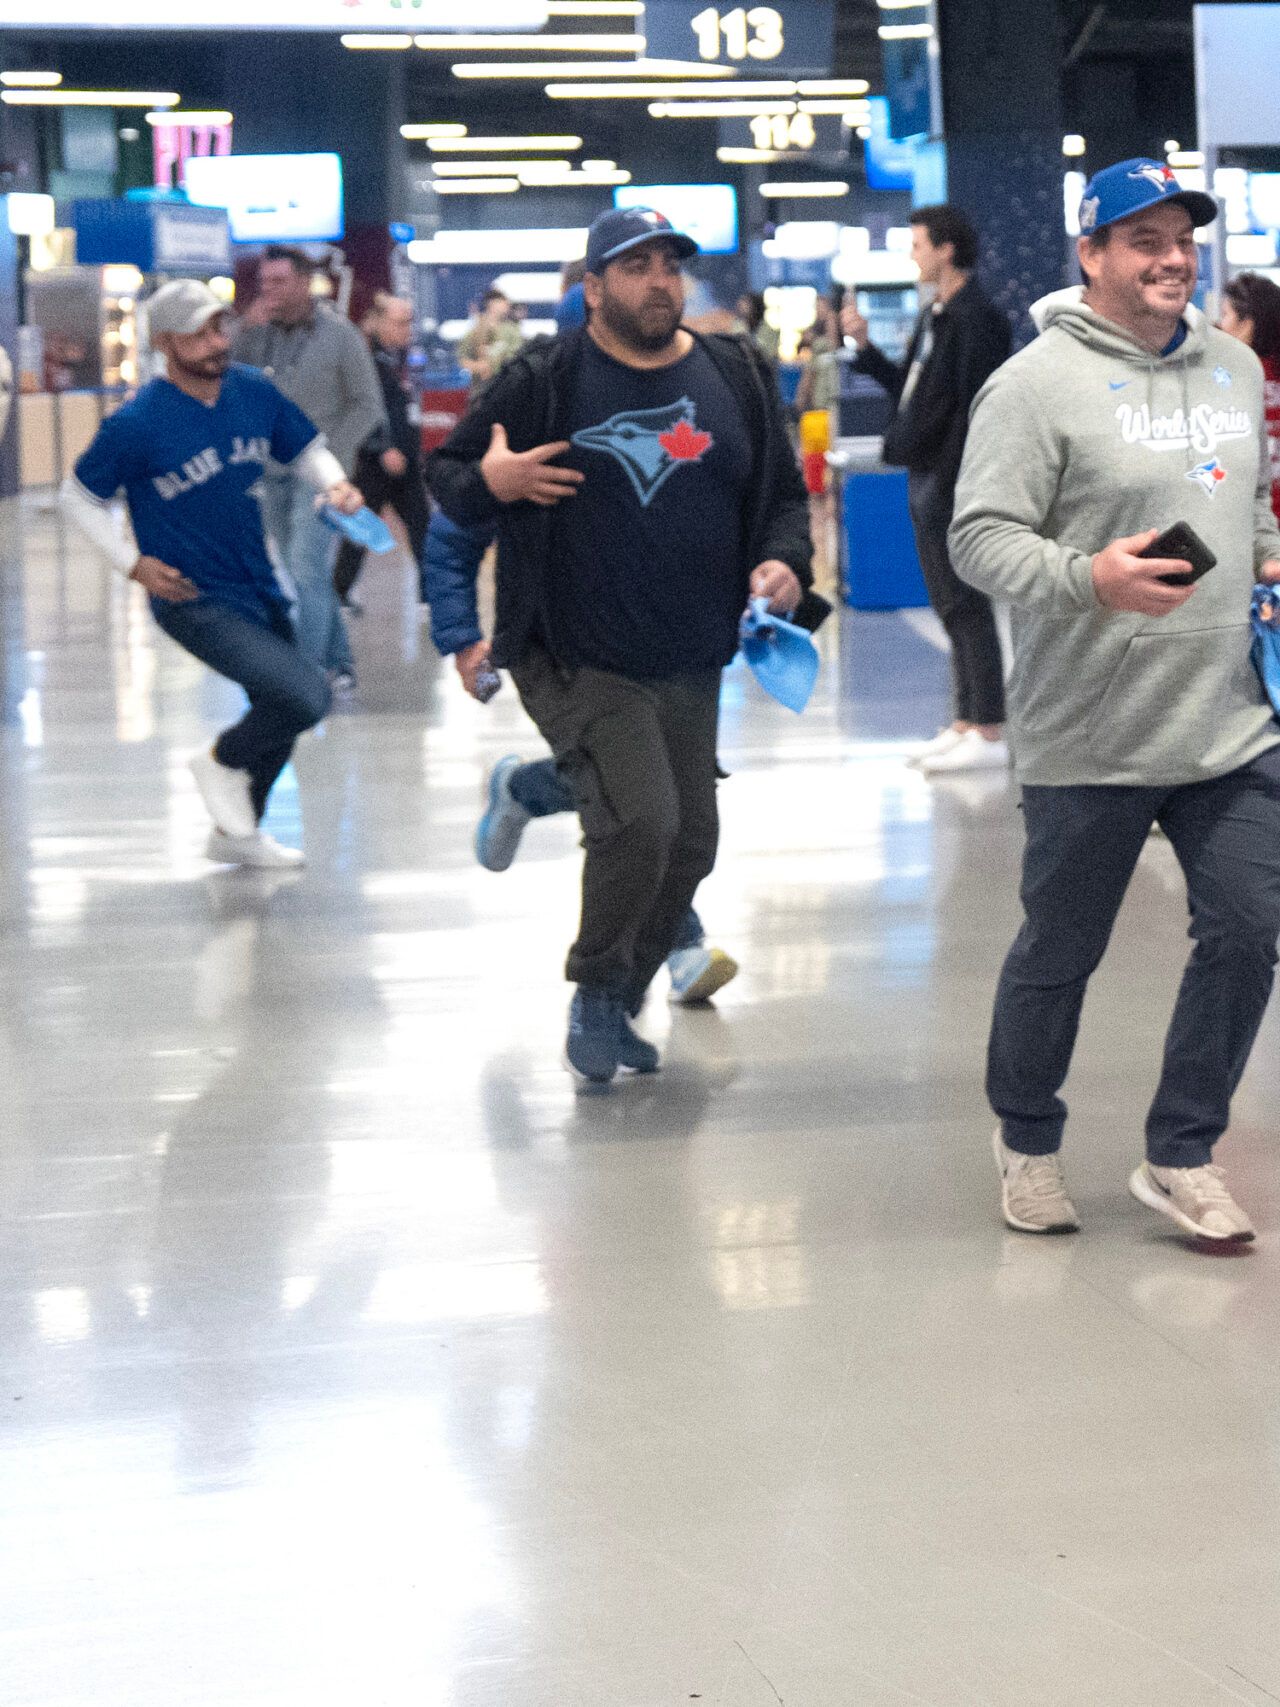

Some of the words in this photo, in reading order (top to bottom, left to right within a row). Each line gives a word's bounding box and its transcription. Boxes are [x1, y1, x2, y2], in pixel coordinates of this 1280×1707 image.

[691, 7, 784, 60] 113
[750, 112, 815, 149] 114
[1115, 403, 1200, 451] World
[152, 446, 224, 500] BLUE
